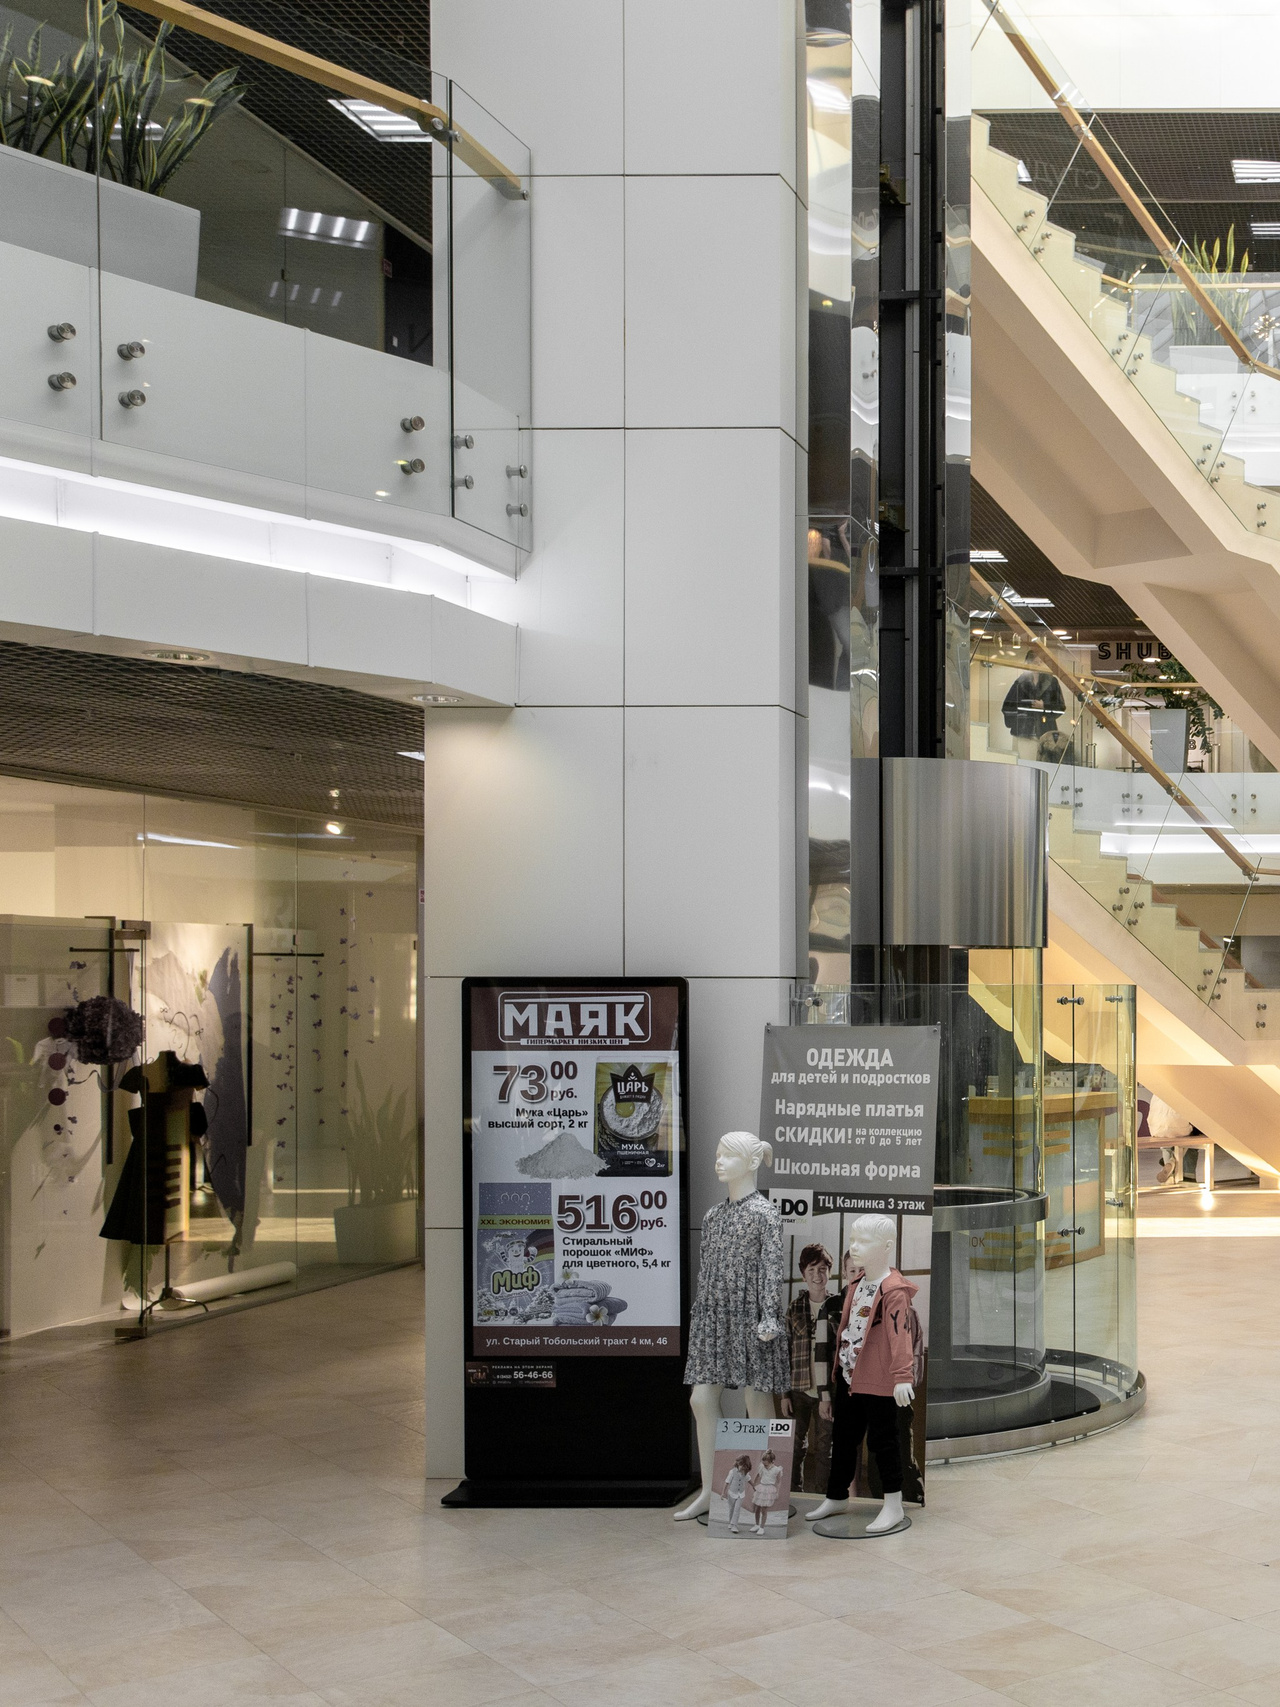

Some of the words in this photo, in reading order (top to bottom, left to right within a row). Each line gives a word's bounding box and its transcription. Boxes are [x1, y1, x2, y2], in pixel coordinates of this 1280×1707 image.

[503, 1003, 645, 1037] МАЯК
[806, 1048, 894, 1070] ОДЕЖДА
[493, 1064, 547, 1103] 73
[550, 1060, 578, 1080] 00
[771, 1072, 795, 1084] для
[798, 1071, 837, 1085] детей
[841, 1073, 849, 1083] и
[852, 1073, 931, 1087] подростков
[551, 1087, 578, 1101] руб.
[617, 1081, 649, 1094] ЦАРЬ
[516, 1108, 544, 1119] Мука
[547, 1108, 588, 1119] «Царь»
[775, 1099, 861, 1118] Нарядные
[865, 1104, 924, 1117] платья
[488, 1119, 534, 1128] высший
[537, 1120, 565, 1130] сорт,
[568, 1119, 575, 1128] 2
[775, 1126, 852, 1146] СКИДКИ!
[855, 1128, 866, 1136] на
[868, 1128, 922, 1138] коллекцию
[621, 1143, 645, 1151] МУКА
[855, 1137, 865, 1145] от
[869, 1136, 875, 1145] 0
[879, 1137, 891, 1146] до
[895, 1136, 902, 1145] 5
[905, 1137, 922, 1146] лет
[774, 1158, 860, 1176] Школьная
[865, 1161, 921, 1181] форма
[818, 1195, 834, 1209] ТЦ
[836, 1197, 885, 1210] Калинка
[887, 1198, 895, 1209] 3
[897, 1200, 925, 1211] этаж
[557, 1194, 639, 1232] 516
[640, 1190, 667, 1209] 00
[641, 1217, 667, 1230] руб.
[562, 1236, 633, 1247] Стиральный
[562, 1249, 612, 1258] порошок
[614, 1248, 654, 1257] «МИФ»
[562, 1260, 583, 1269] для
[586, 1260, 639, 1269] цветного,
[642, 1259, 658, 1269] 5,4
[661, 1260, 671, 1268] кг
[492, 1266, 541, 1295] Миф
[486, 1338, 500, 1347] ул.
[503, 1336, 540, 1347] Старый
[543, 1336, 600, 1346] Тобольский
[603, 1338, 628, 1347] тракт
[630, 1337, 637, 1345] 4
[639, 1338, 654, 1347] км,
[656, 1337, 668, 1345] 46
[513, 1371, 553, 1379] 56-46-66
[721, 1421, 729, 1433] 3
[733, 1421, 766, 1434] Этаж
